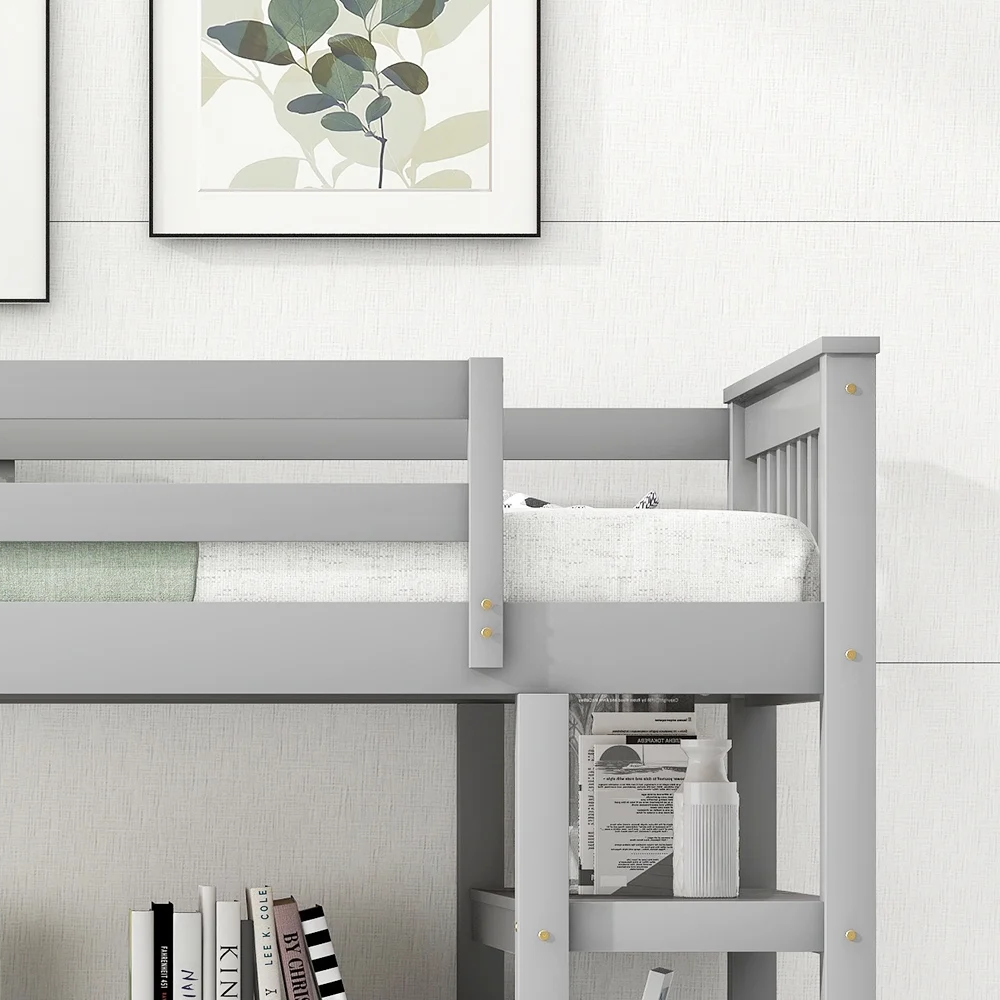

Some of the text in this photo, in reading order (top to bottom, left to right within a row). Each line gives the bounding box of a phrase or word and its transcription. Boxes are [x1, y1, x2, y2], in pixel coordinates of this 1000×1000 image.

[258, 889, 272, 966] LEE K. COLE
[283, 931, 302, 954] BY
[160, 945, 168, 979] FAHRENHEIT
